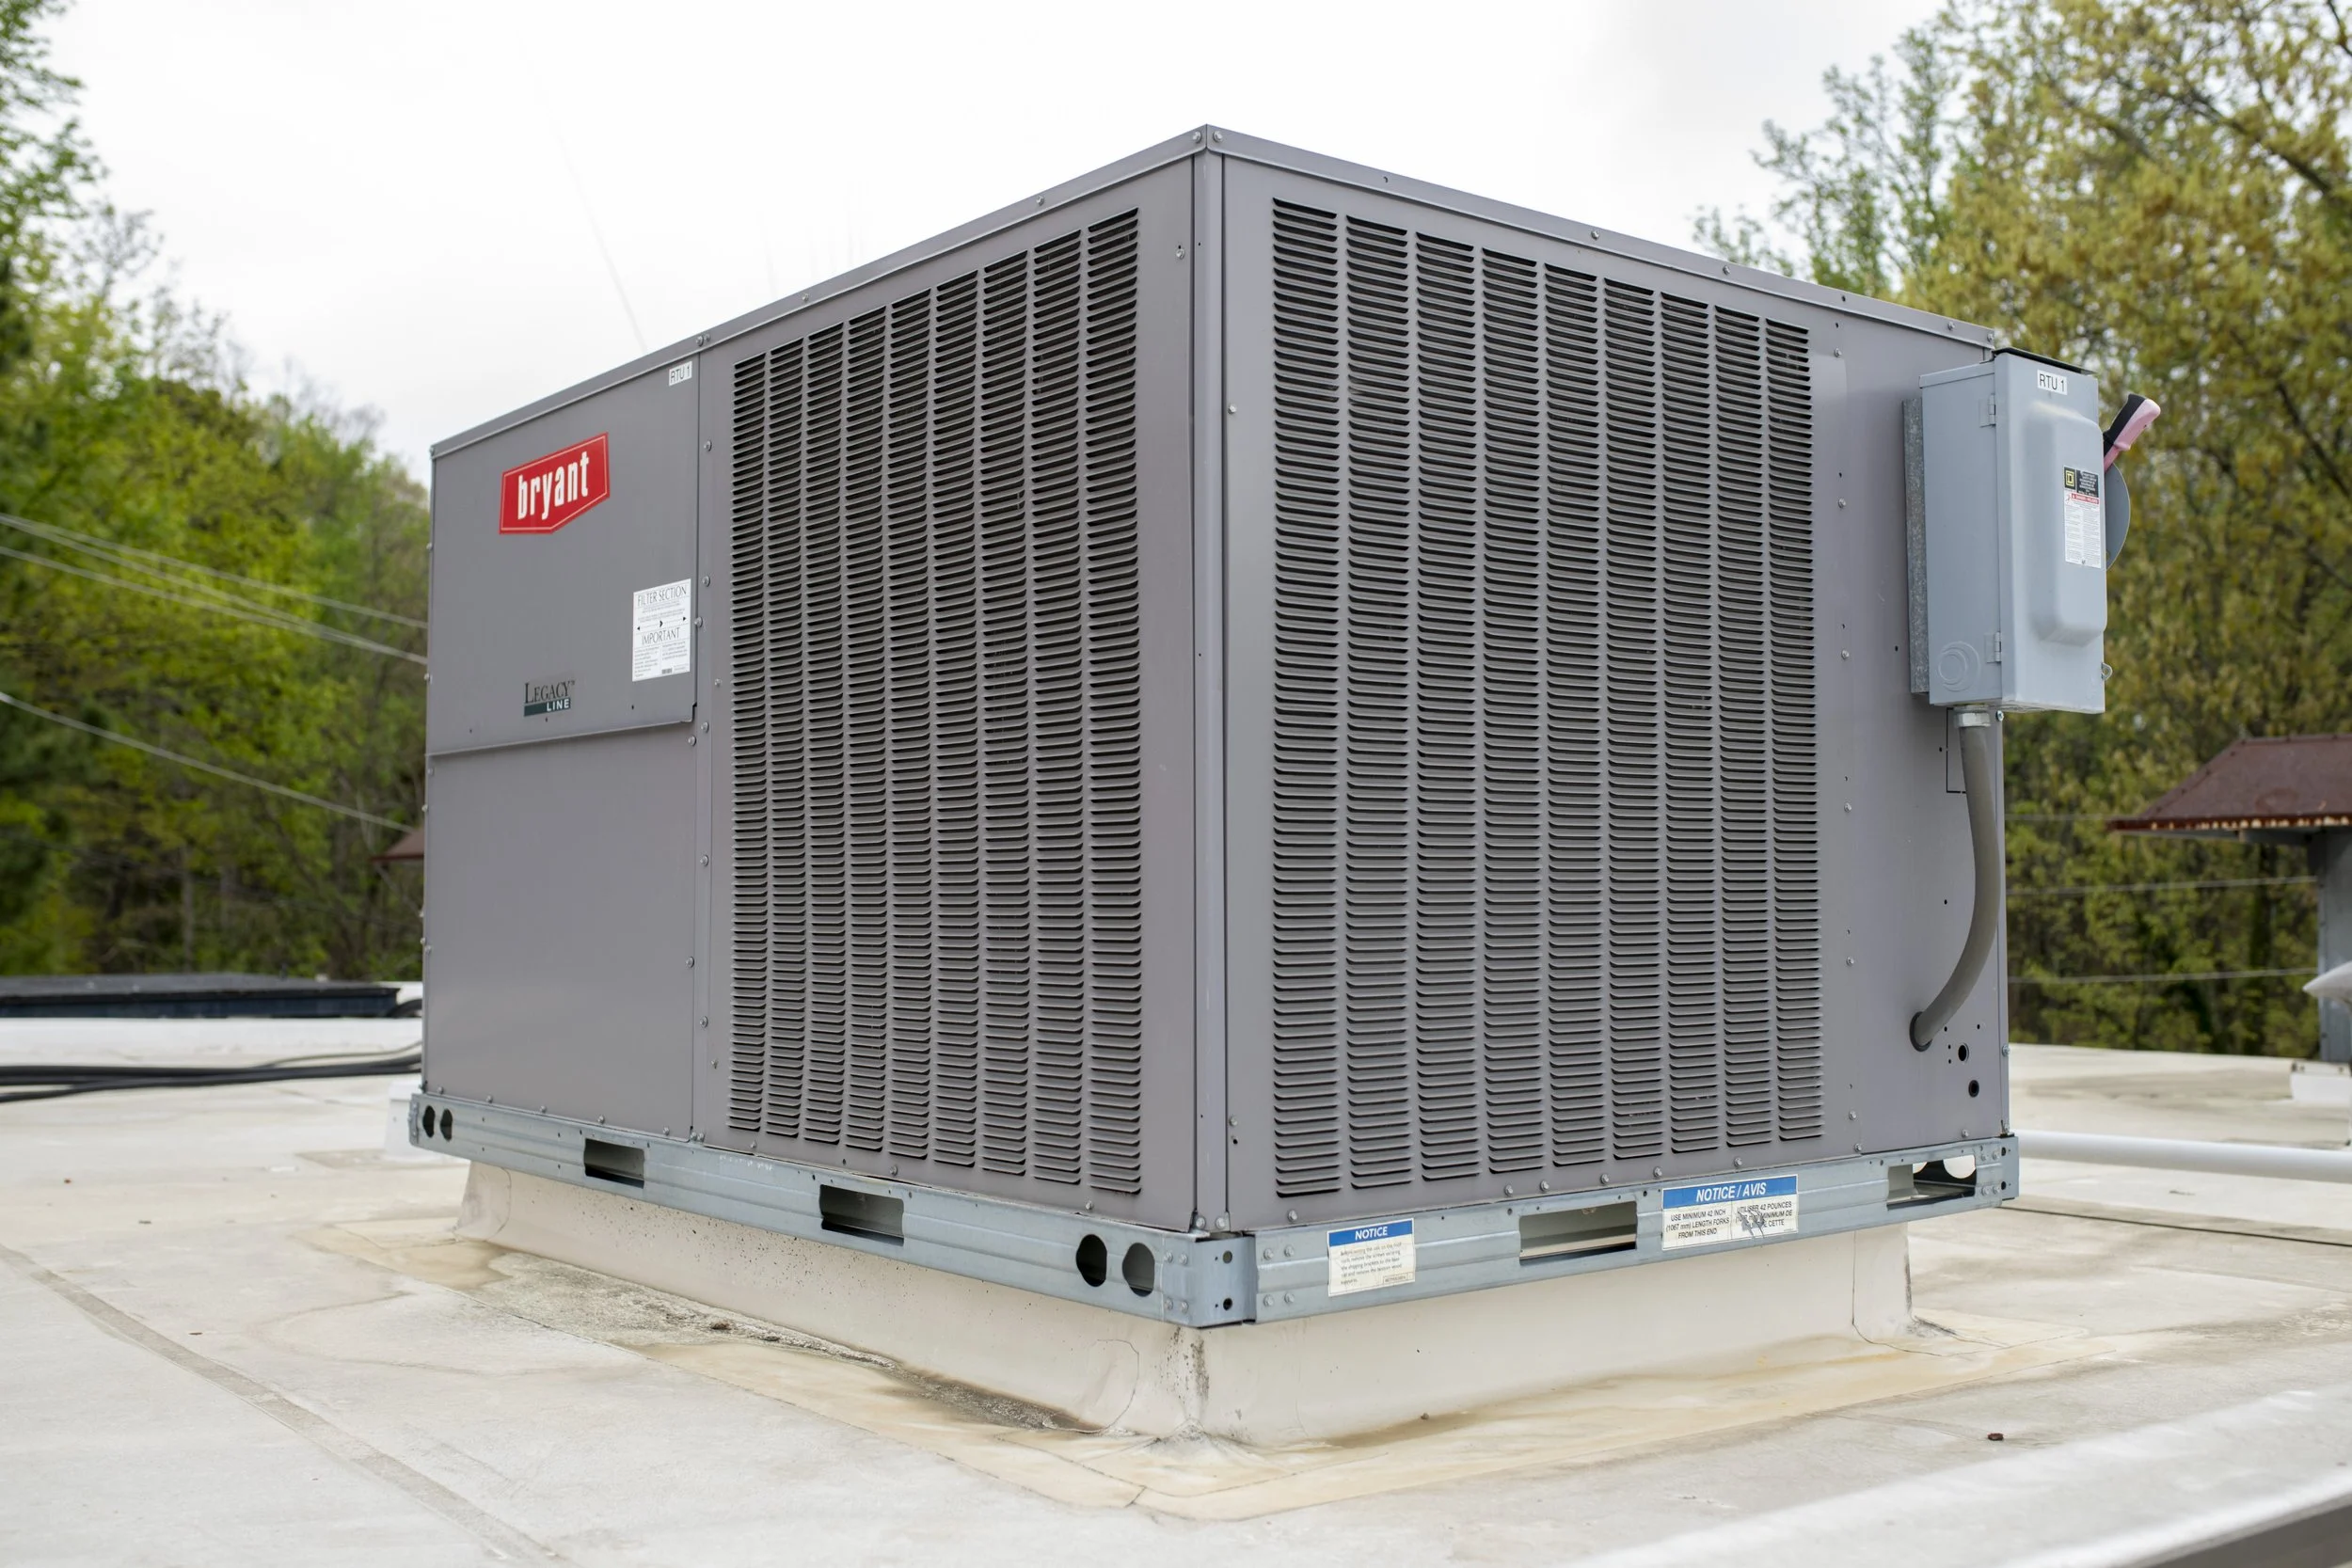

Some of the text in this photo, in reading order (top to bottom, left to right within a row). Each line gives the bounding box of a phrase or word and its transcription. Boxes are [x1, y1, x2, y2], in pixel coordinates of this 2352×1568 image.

[671, 368, 685, 384] RTU
[2040, 373, 2065, 392] RTU 1
[517, 451, 589, 520] bryant
[638, 591, 657, 608] FILTER
[659, 584, 687, 602] SECTION
[642, 626, 680, 645] IMPORTANT
[547, 698, 569, 712] LINE
[1696, 1185, 1736, 1202] NOTICE
[1742, 1182, 1767, 1197] AVIS
[1671, 1213, 1681, 1222] USE
[1682, 1211, 1706, 1220] MINIMUM
[1713, 1208, 1726, 1216] INCH
[1769, 1218, 1785, 1227] CETTE
[1666, 1223, 1679, 1232] (1067
[1692, 1219, 1712, 1228] LENGTH
[1712, 1216, 1730, 1226] FORKS
[1355, 1226, 1389, 1241] NOTICE
[1678, 1227, 1718, 1239] FROM THIS END
